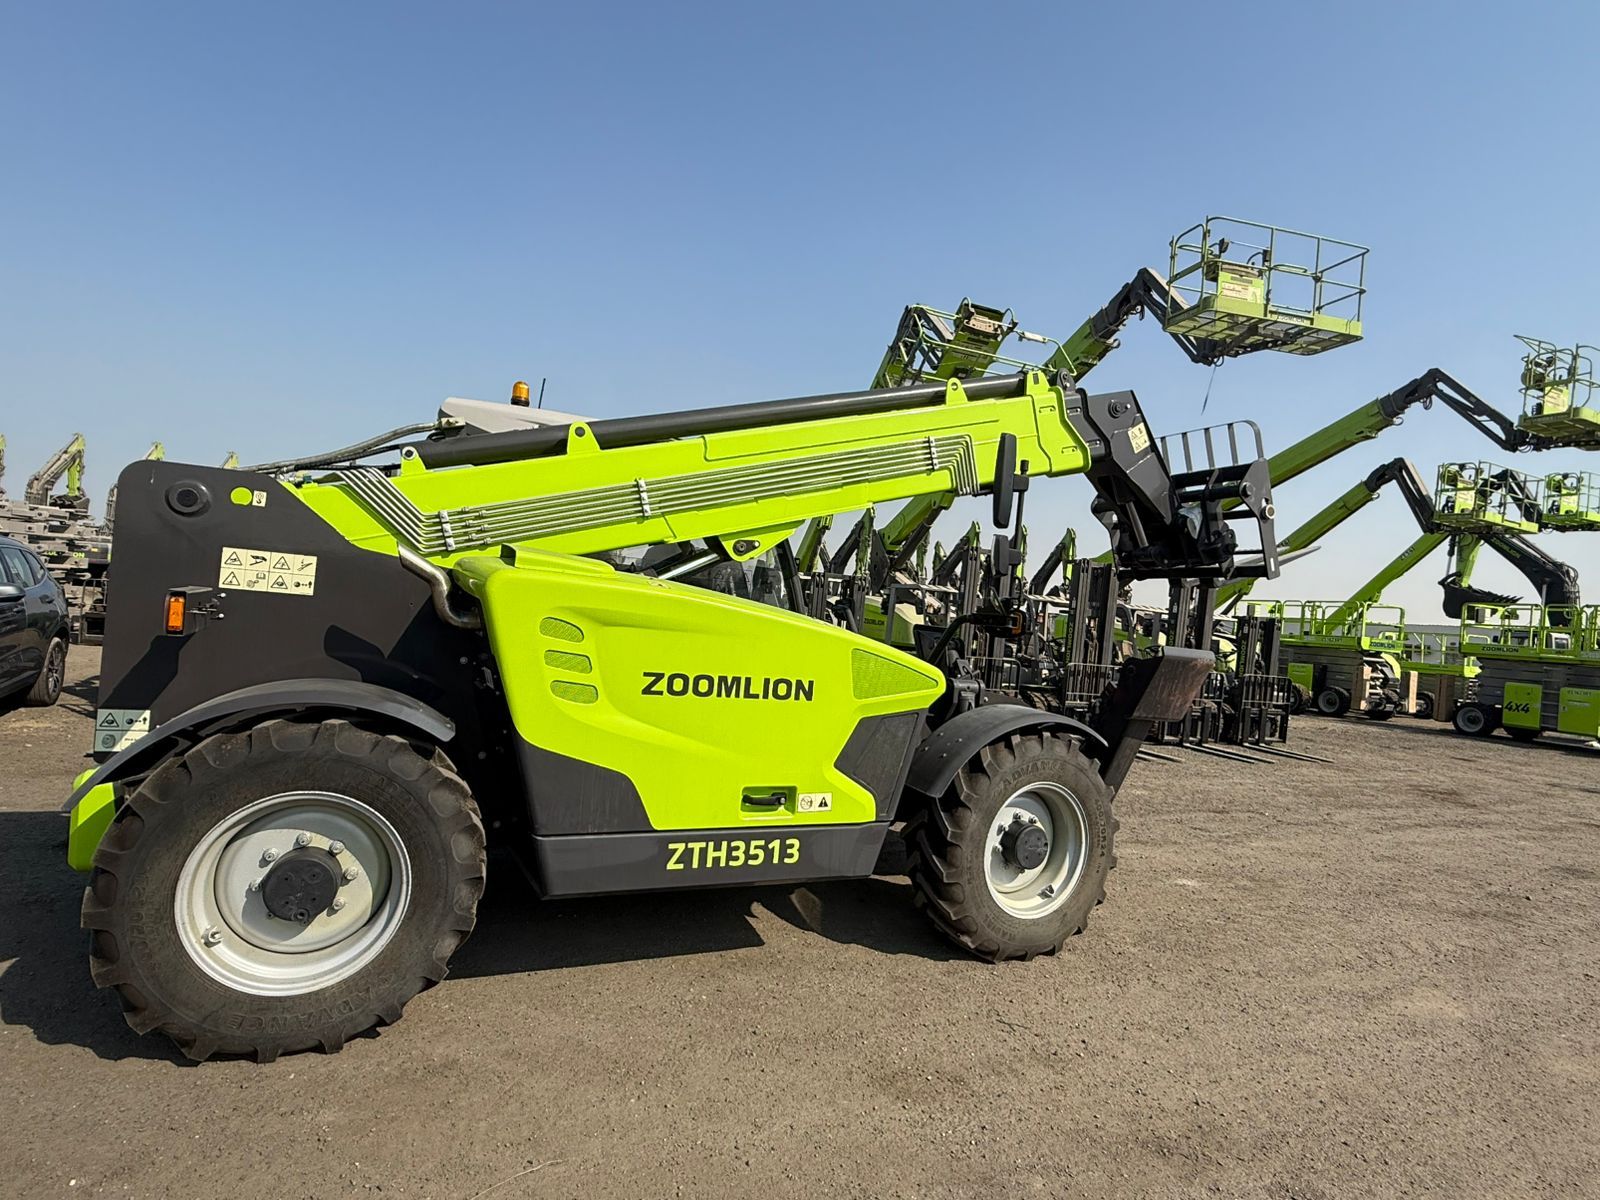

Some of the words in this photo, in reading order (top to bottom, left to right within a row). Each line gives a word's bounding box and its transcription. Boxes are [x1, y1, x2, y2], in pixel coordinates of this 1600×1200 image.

[1065, 622, 1074, 663] ZOOMLION
[1238, 640, 1246, 677] ZOOMLION
[1370, 641, 1395, 649] ZOOMLION
[641, 671, 815, 702] ZOOMLION
[1003, 760, 1065, 785] ADVANCE
[666, 838, 801, 871] ZTH3513
[226, 989, 375, 1033] ADVANCE
